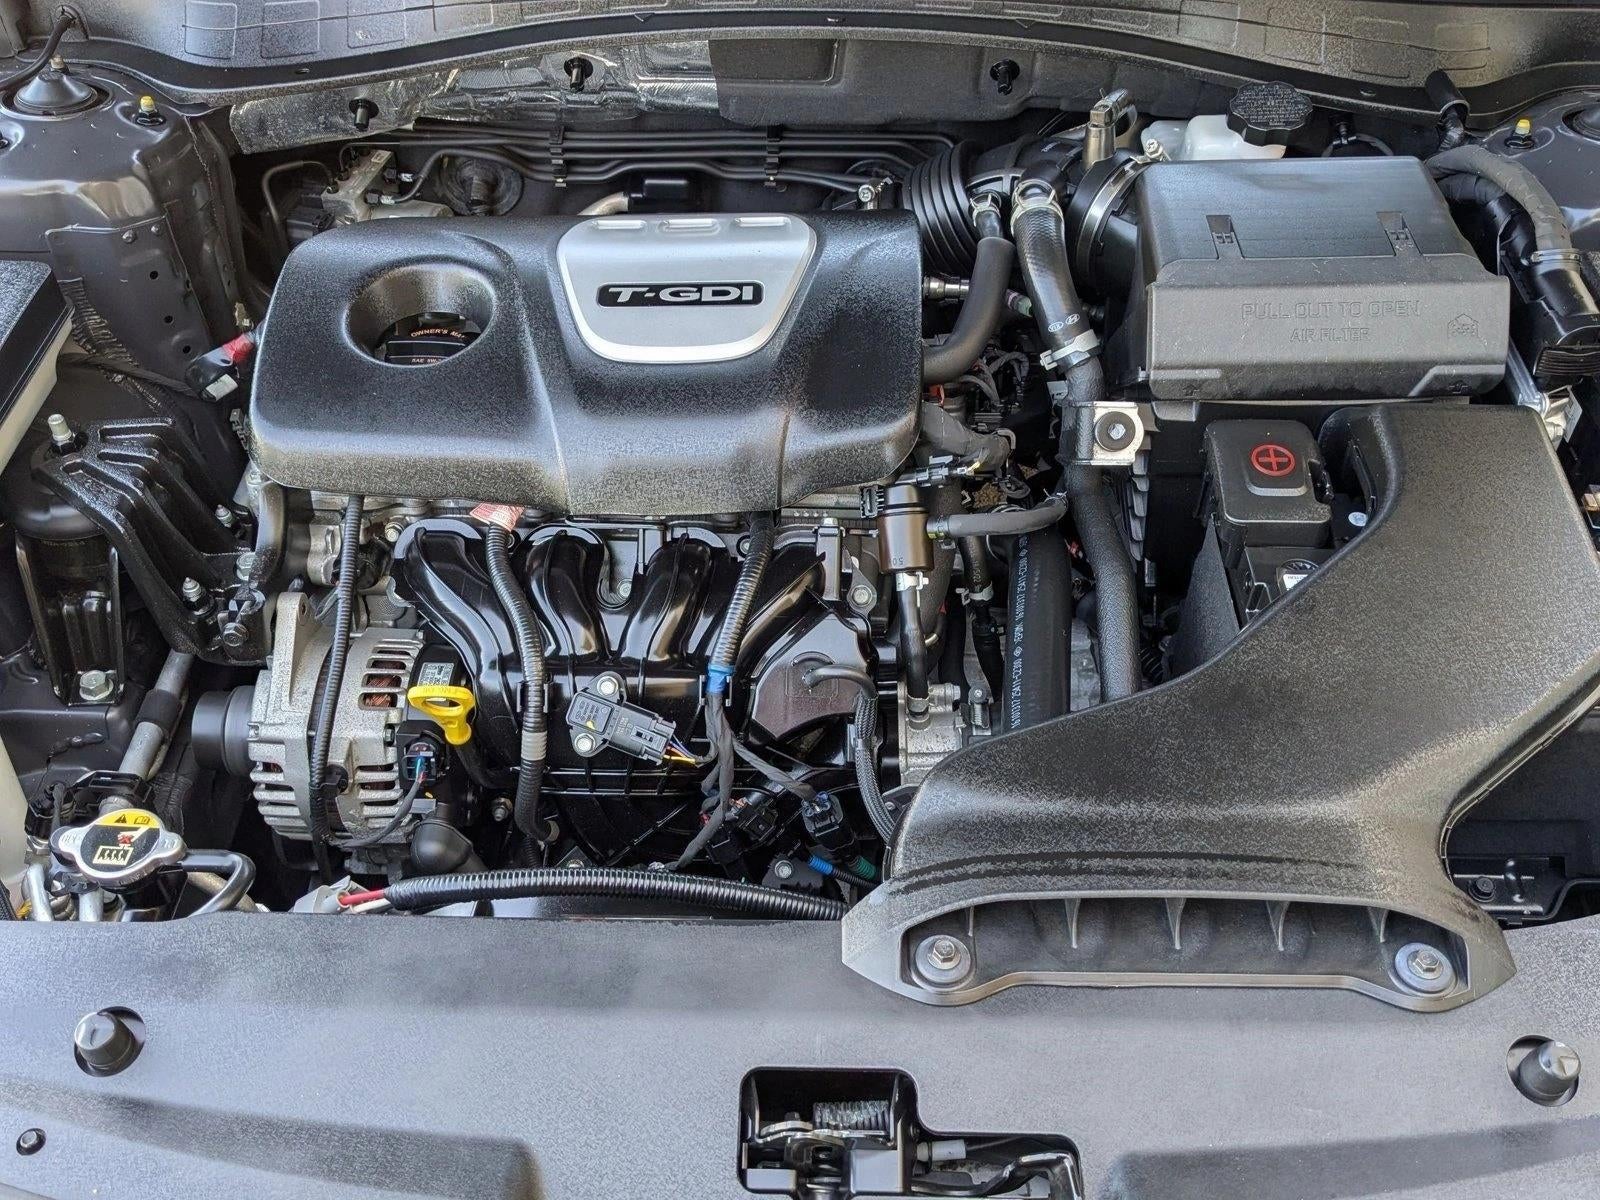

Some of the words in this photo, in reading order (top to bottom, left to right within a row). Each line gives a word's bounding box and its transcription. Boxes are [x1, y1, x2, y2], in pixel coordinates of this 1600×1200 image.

[608, 285, 754, 303] T-GDI
[1241, 302, 1291, 320] PULL
[1295, 302, 1333, 319] OUT
[1338, 301, 1362, 318] TO
[1369, 300, 1421, 318] OPEN
[410, 328, 449, 338] OWNER'S
[1290, 328, 1315, 342] AIR
[1319, 328, 1370, 342] FILTER
